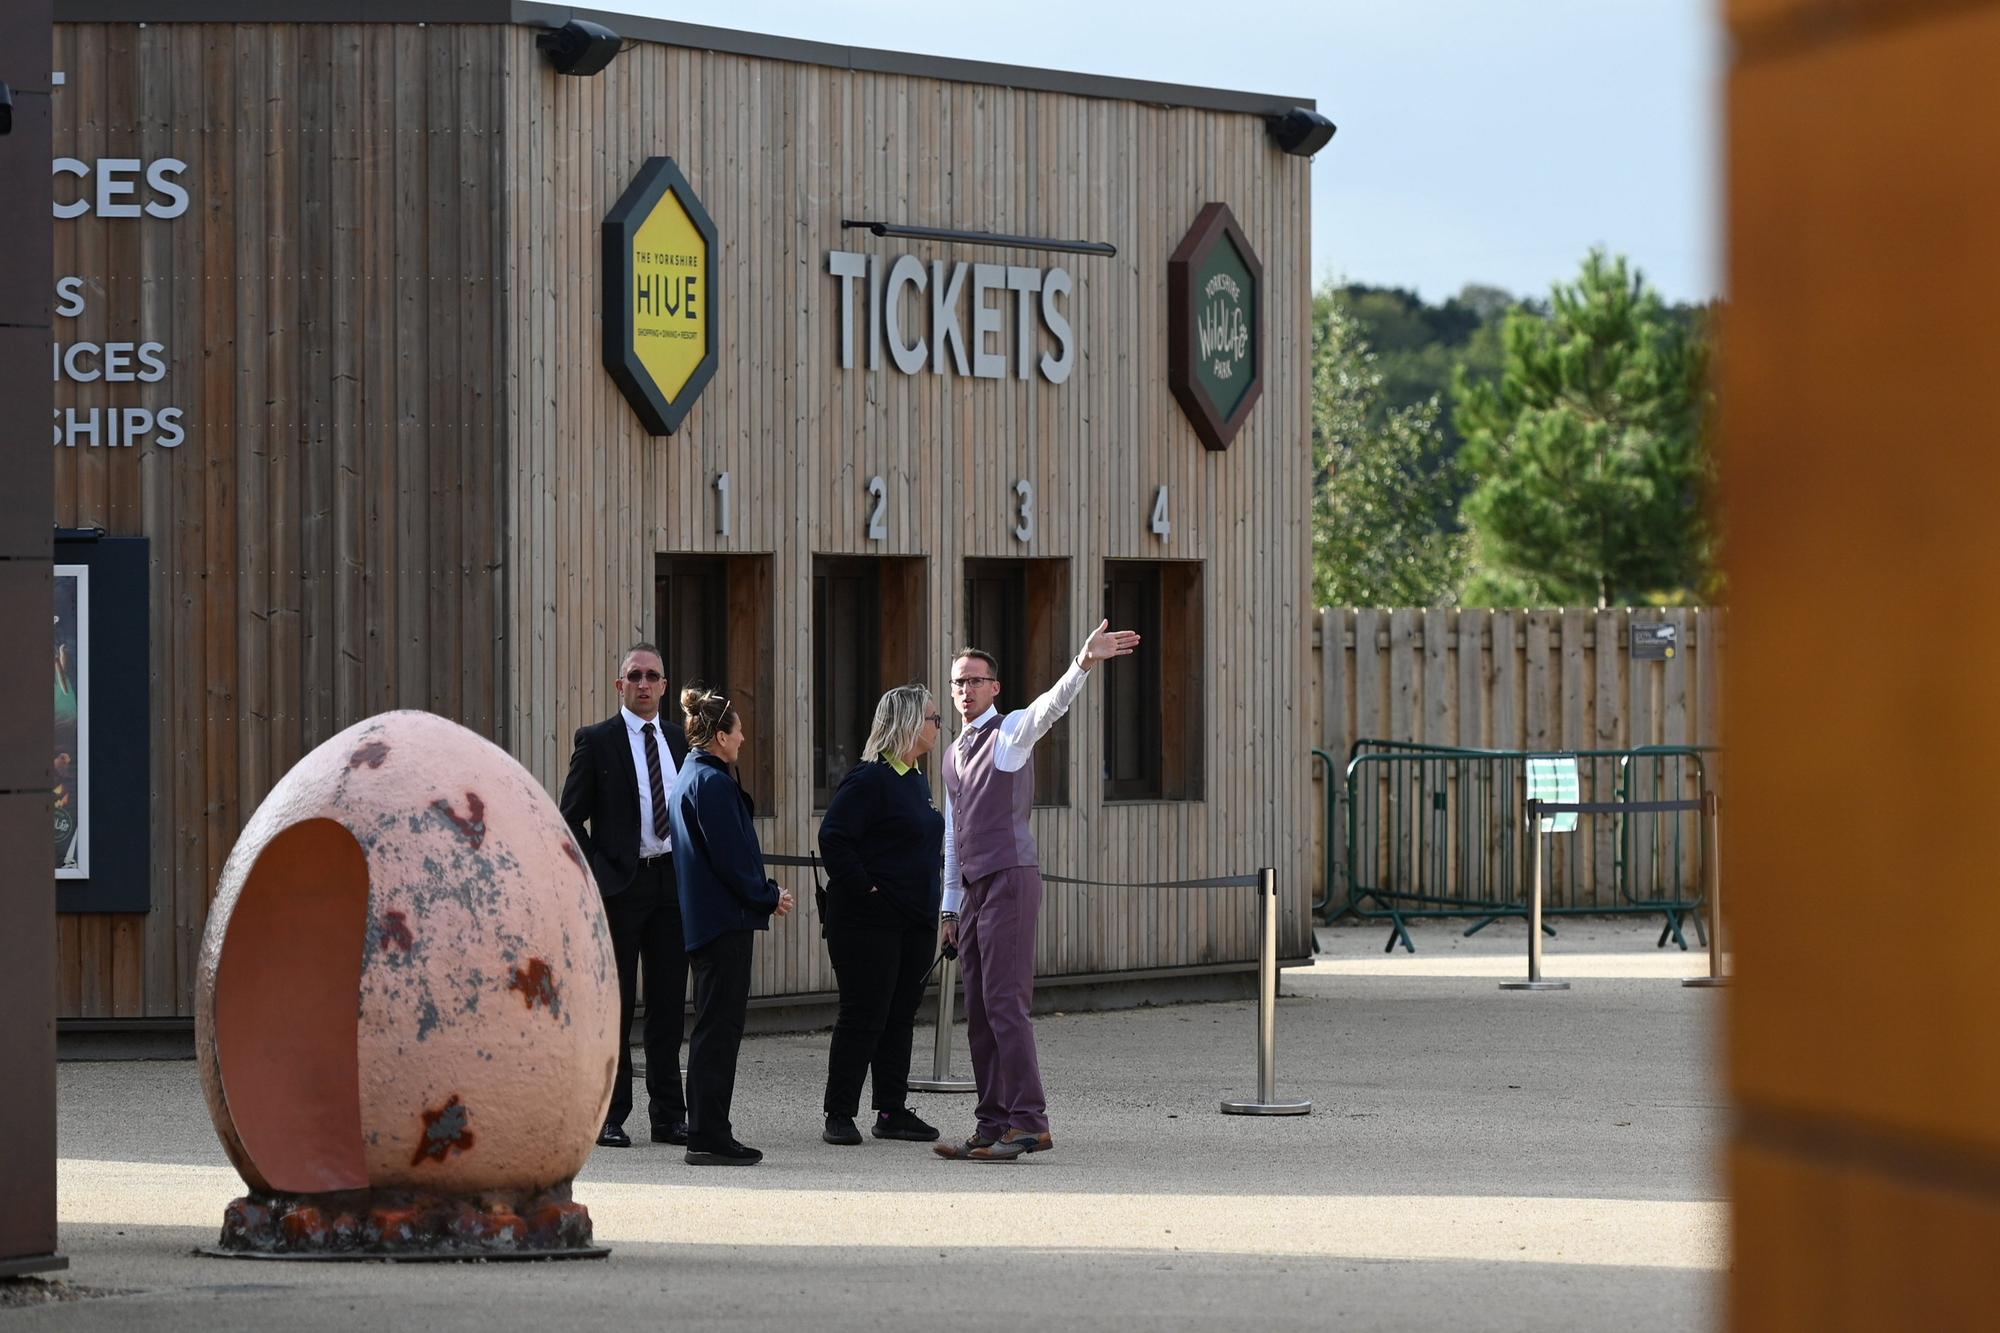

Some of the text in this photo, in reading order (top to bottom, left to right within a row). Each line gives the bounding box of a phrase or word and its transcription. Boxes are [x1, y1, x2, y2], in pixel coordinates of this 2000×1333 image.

[636, 251, 698, 268] THE YORKSHIRE
[637, 273, 698, 319] HIVE
[1205, 273, 1241, 303] YORKSHIRE
[829, 251, 1074, 385] TICKETS
[1213, 358, 1233, 379] PARK
[53, 406, 185, 448] HIPS
[718, 472, 730, 536] 1
[869, 475, 888, 539] 2
[1016, 479, 1034, 542] 3
[1152, 485, 1170, 545] 4
